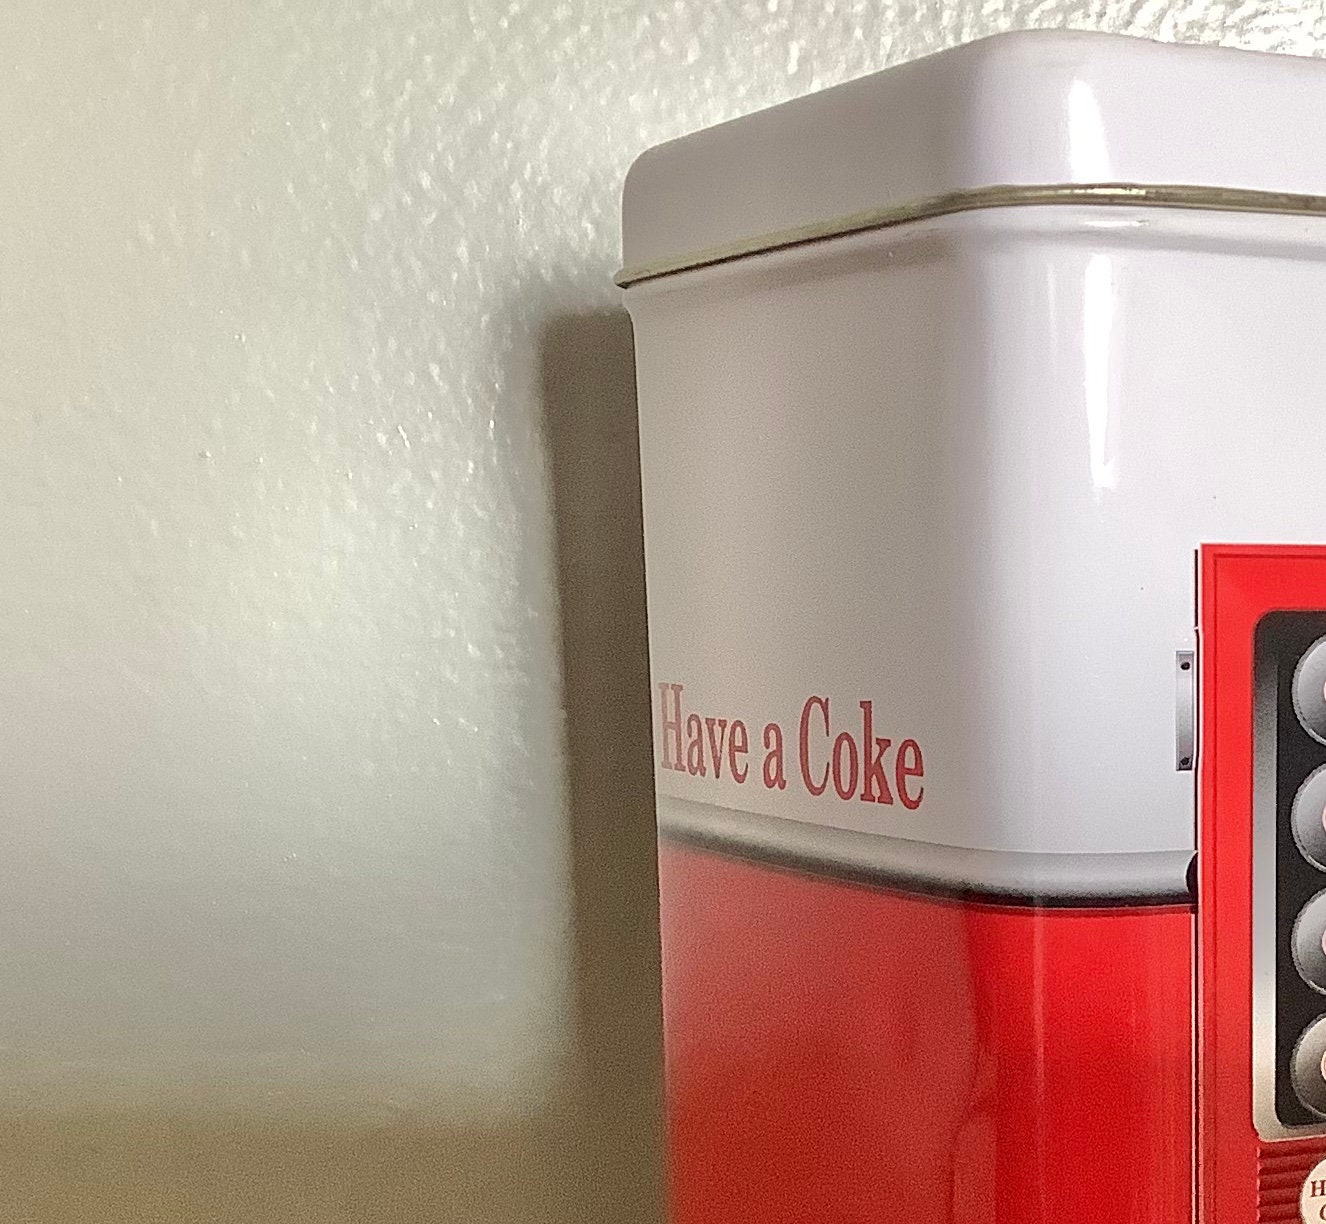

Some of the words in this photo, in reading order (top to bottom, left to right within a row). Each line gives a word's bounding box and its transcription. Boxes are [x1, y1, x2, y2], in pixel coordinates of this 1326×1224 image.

[658, 682, 749, 784] Have
[763, 722, 787, 791] a
[799, 695, 924, 810] Coke
